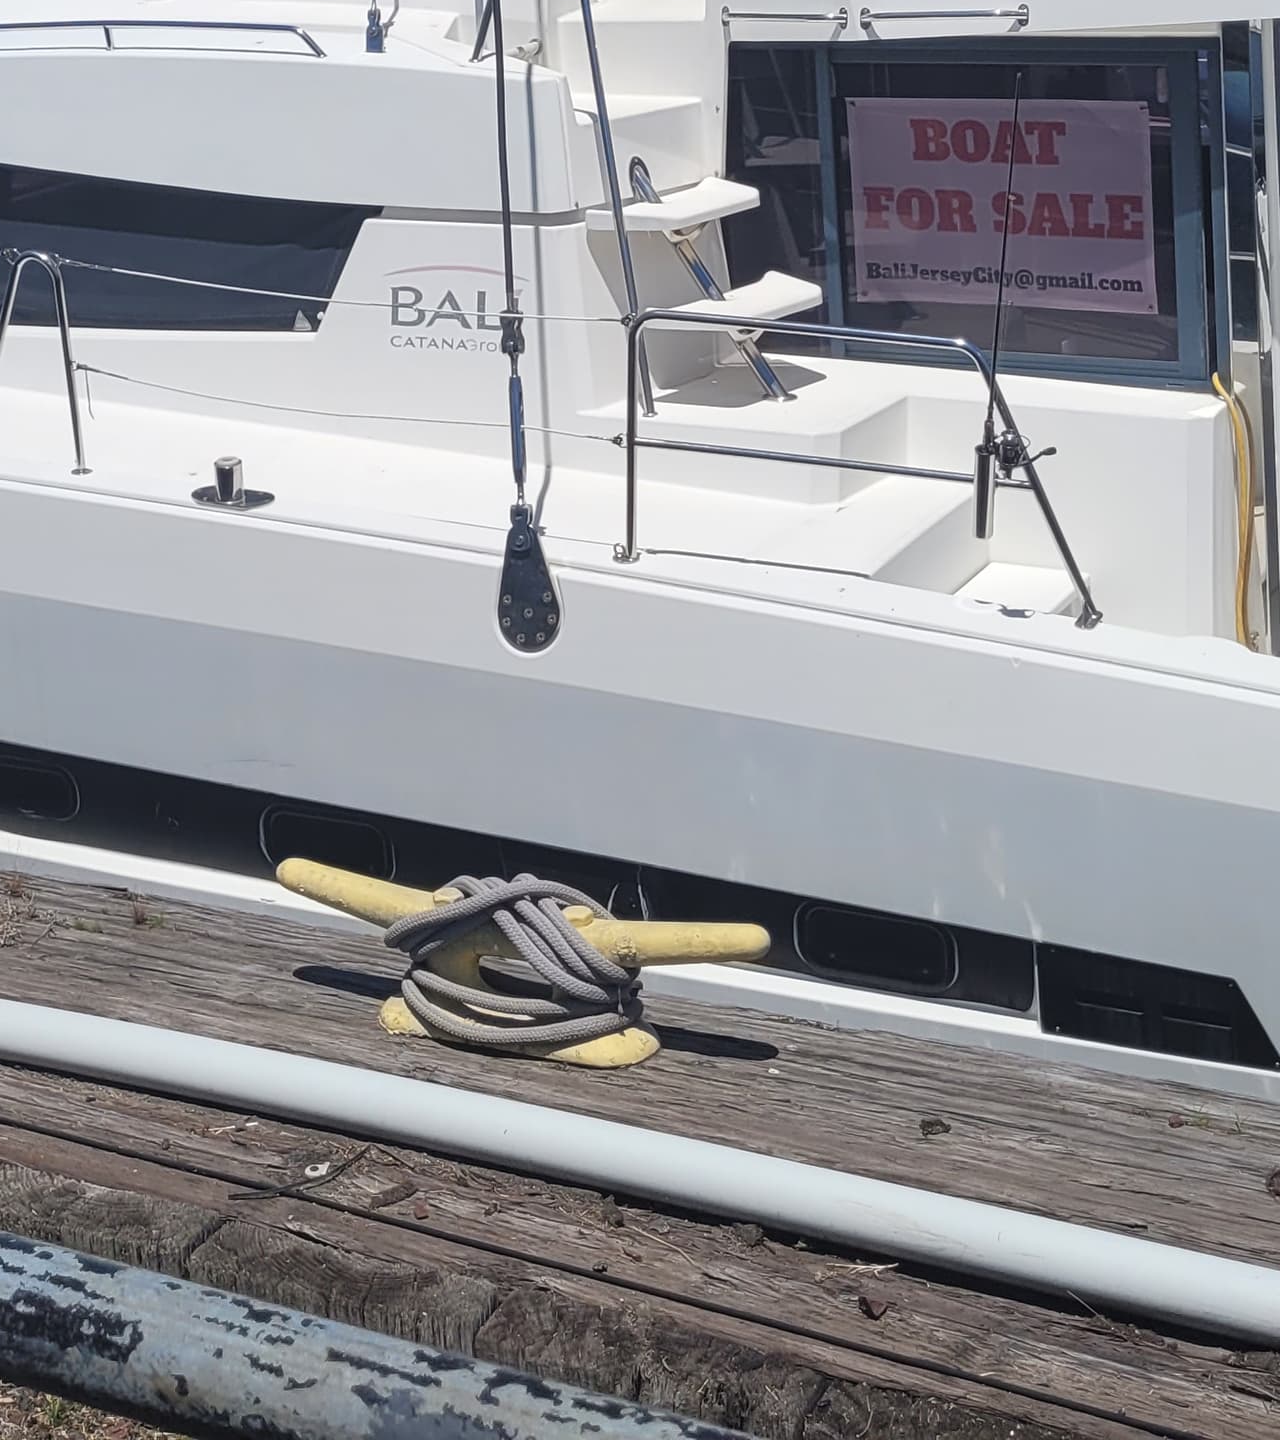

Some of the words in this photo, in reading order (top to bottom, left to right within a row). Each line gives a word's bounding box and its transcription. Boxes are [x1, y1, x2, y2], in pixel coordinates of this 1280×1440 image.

[909, 117, 1067, 166] BOAT
[863, 186, 977, 233] FOR
[990, 191, 1145, 241] SALE
[865, 261, 1144, 294] BaliJerseyCity@gmail.com
